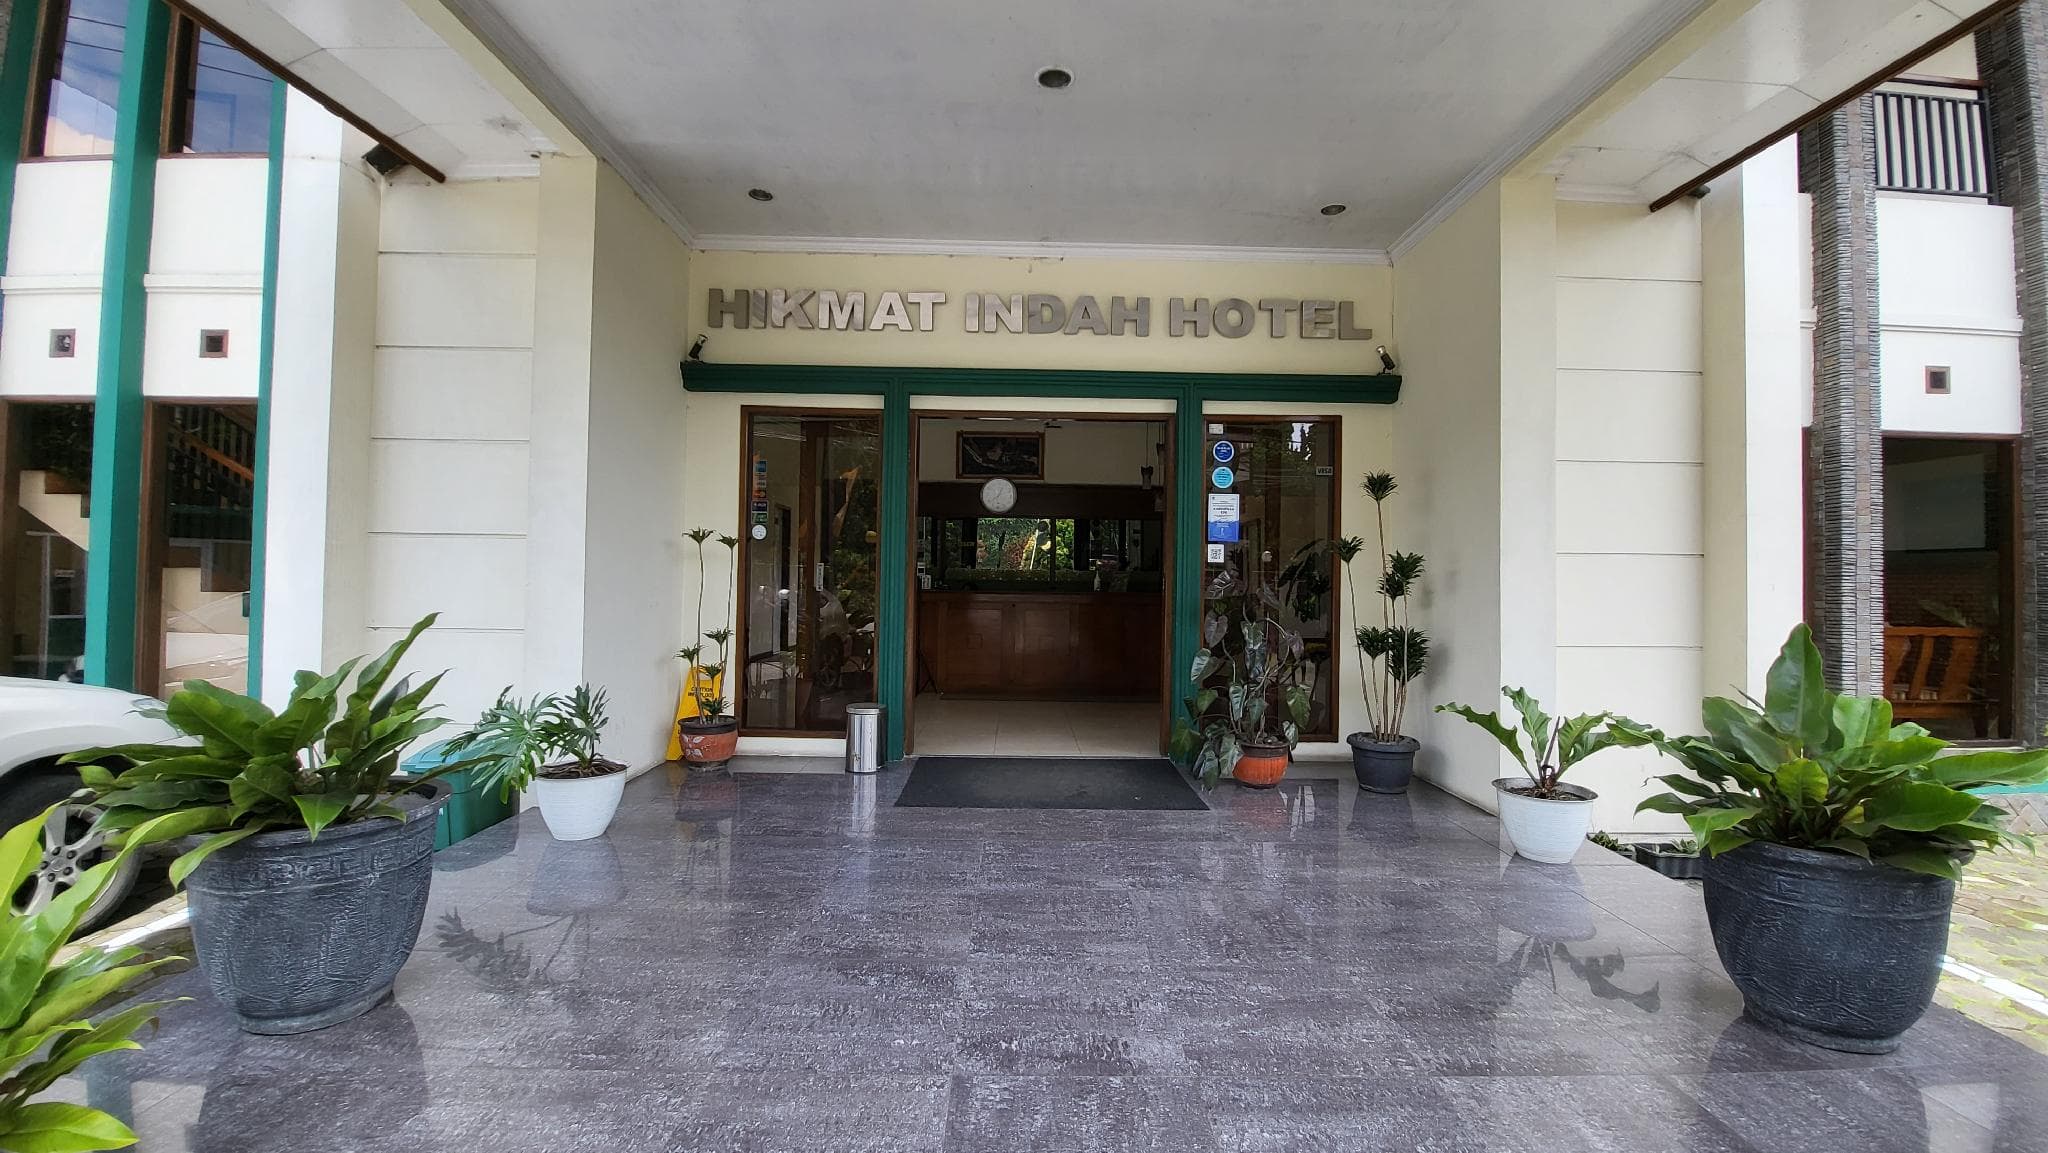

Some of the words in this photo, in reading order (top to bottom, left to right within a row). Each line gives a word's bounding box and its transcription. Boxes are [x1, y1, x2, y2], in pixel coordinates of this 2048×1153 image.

[707, 288, 947, 332] HIKMAT
[965, 292, 1151, 337] INDAH
[1169, 297, 1373, 341] HOTEL
